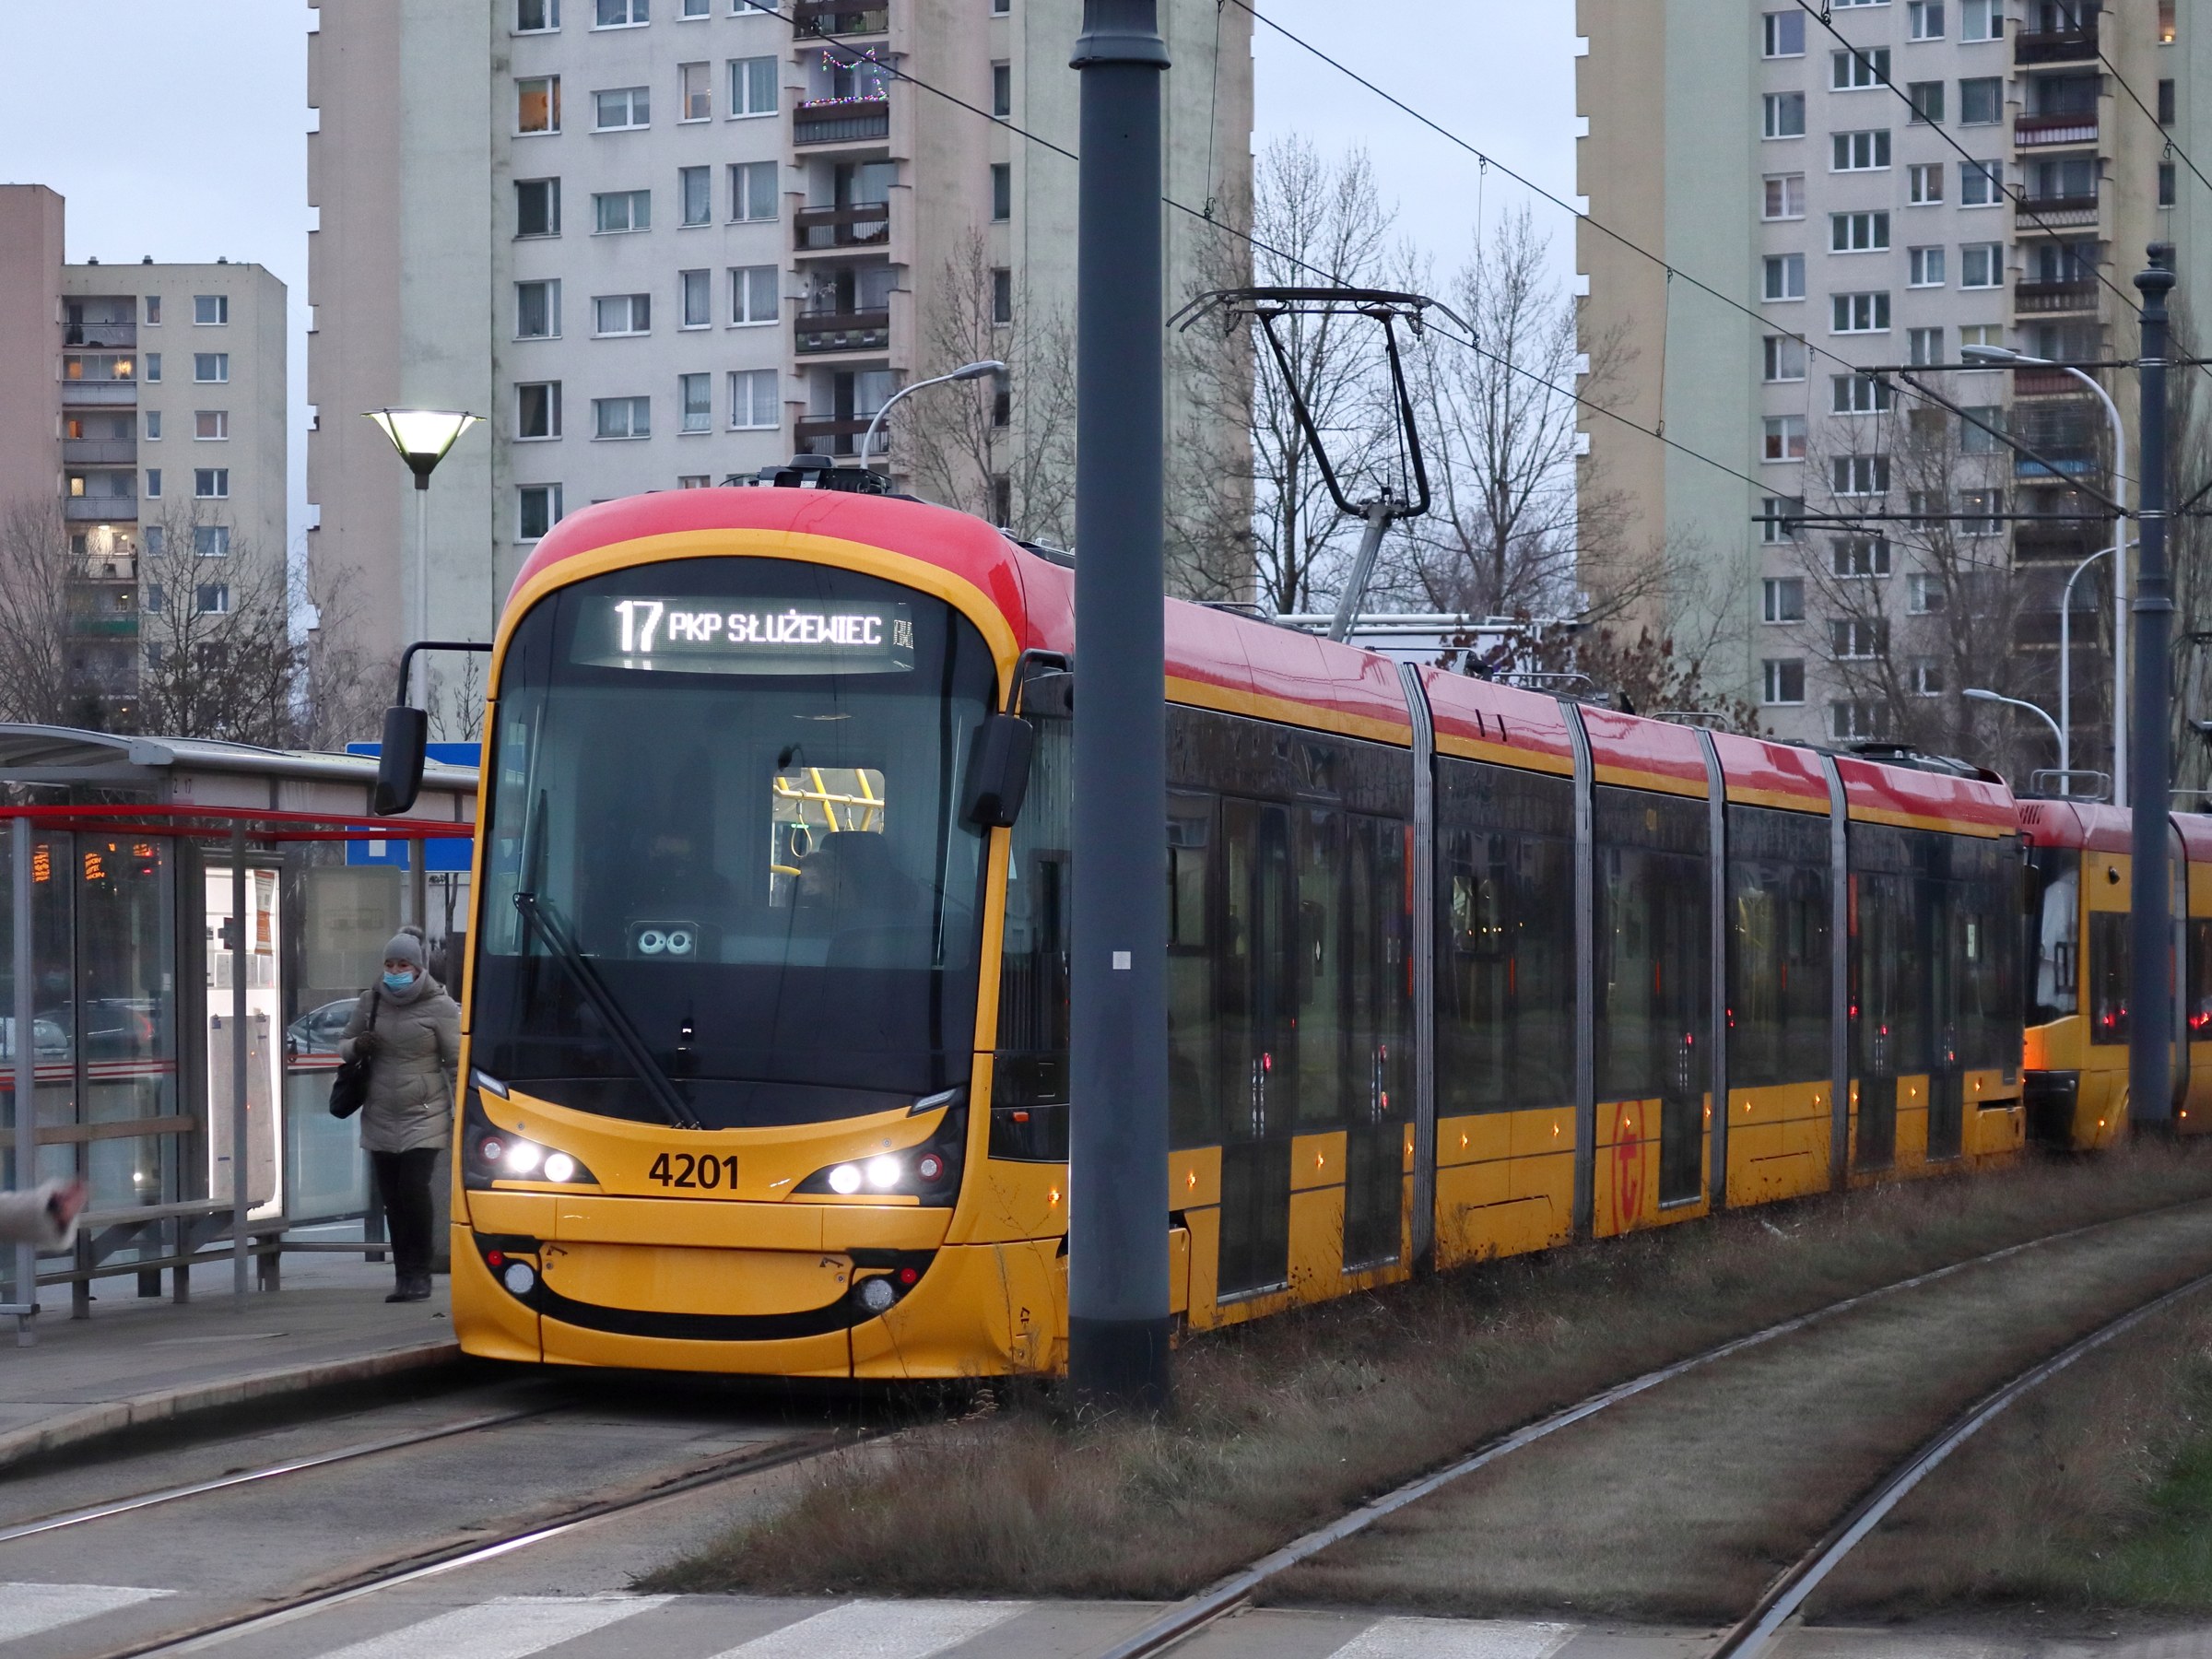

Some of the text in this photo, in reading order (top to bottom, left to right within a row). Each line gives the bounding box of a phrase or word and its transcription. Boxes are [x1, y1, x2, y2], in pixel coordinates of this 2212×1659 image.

[615, 601, 663, 651] 17
[669, 612, 721, 641] PKP
[728, 608, 882, 644] SŁUŻEWIEC
[649, 1153, 737, 1189] 4201
